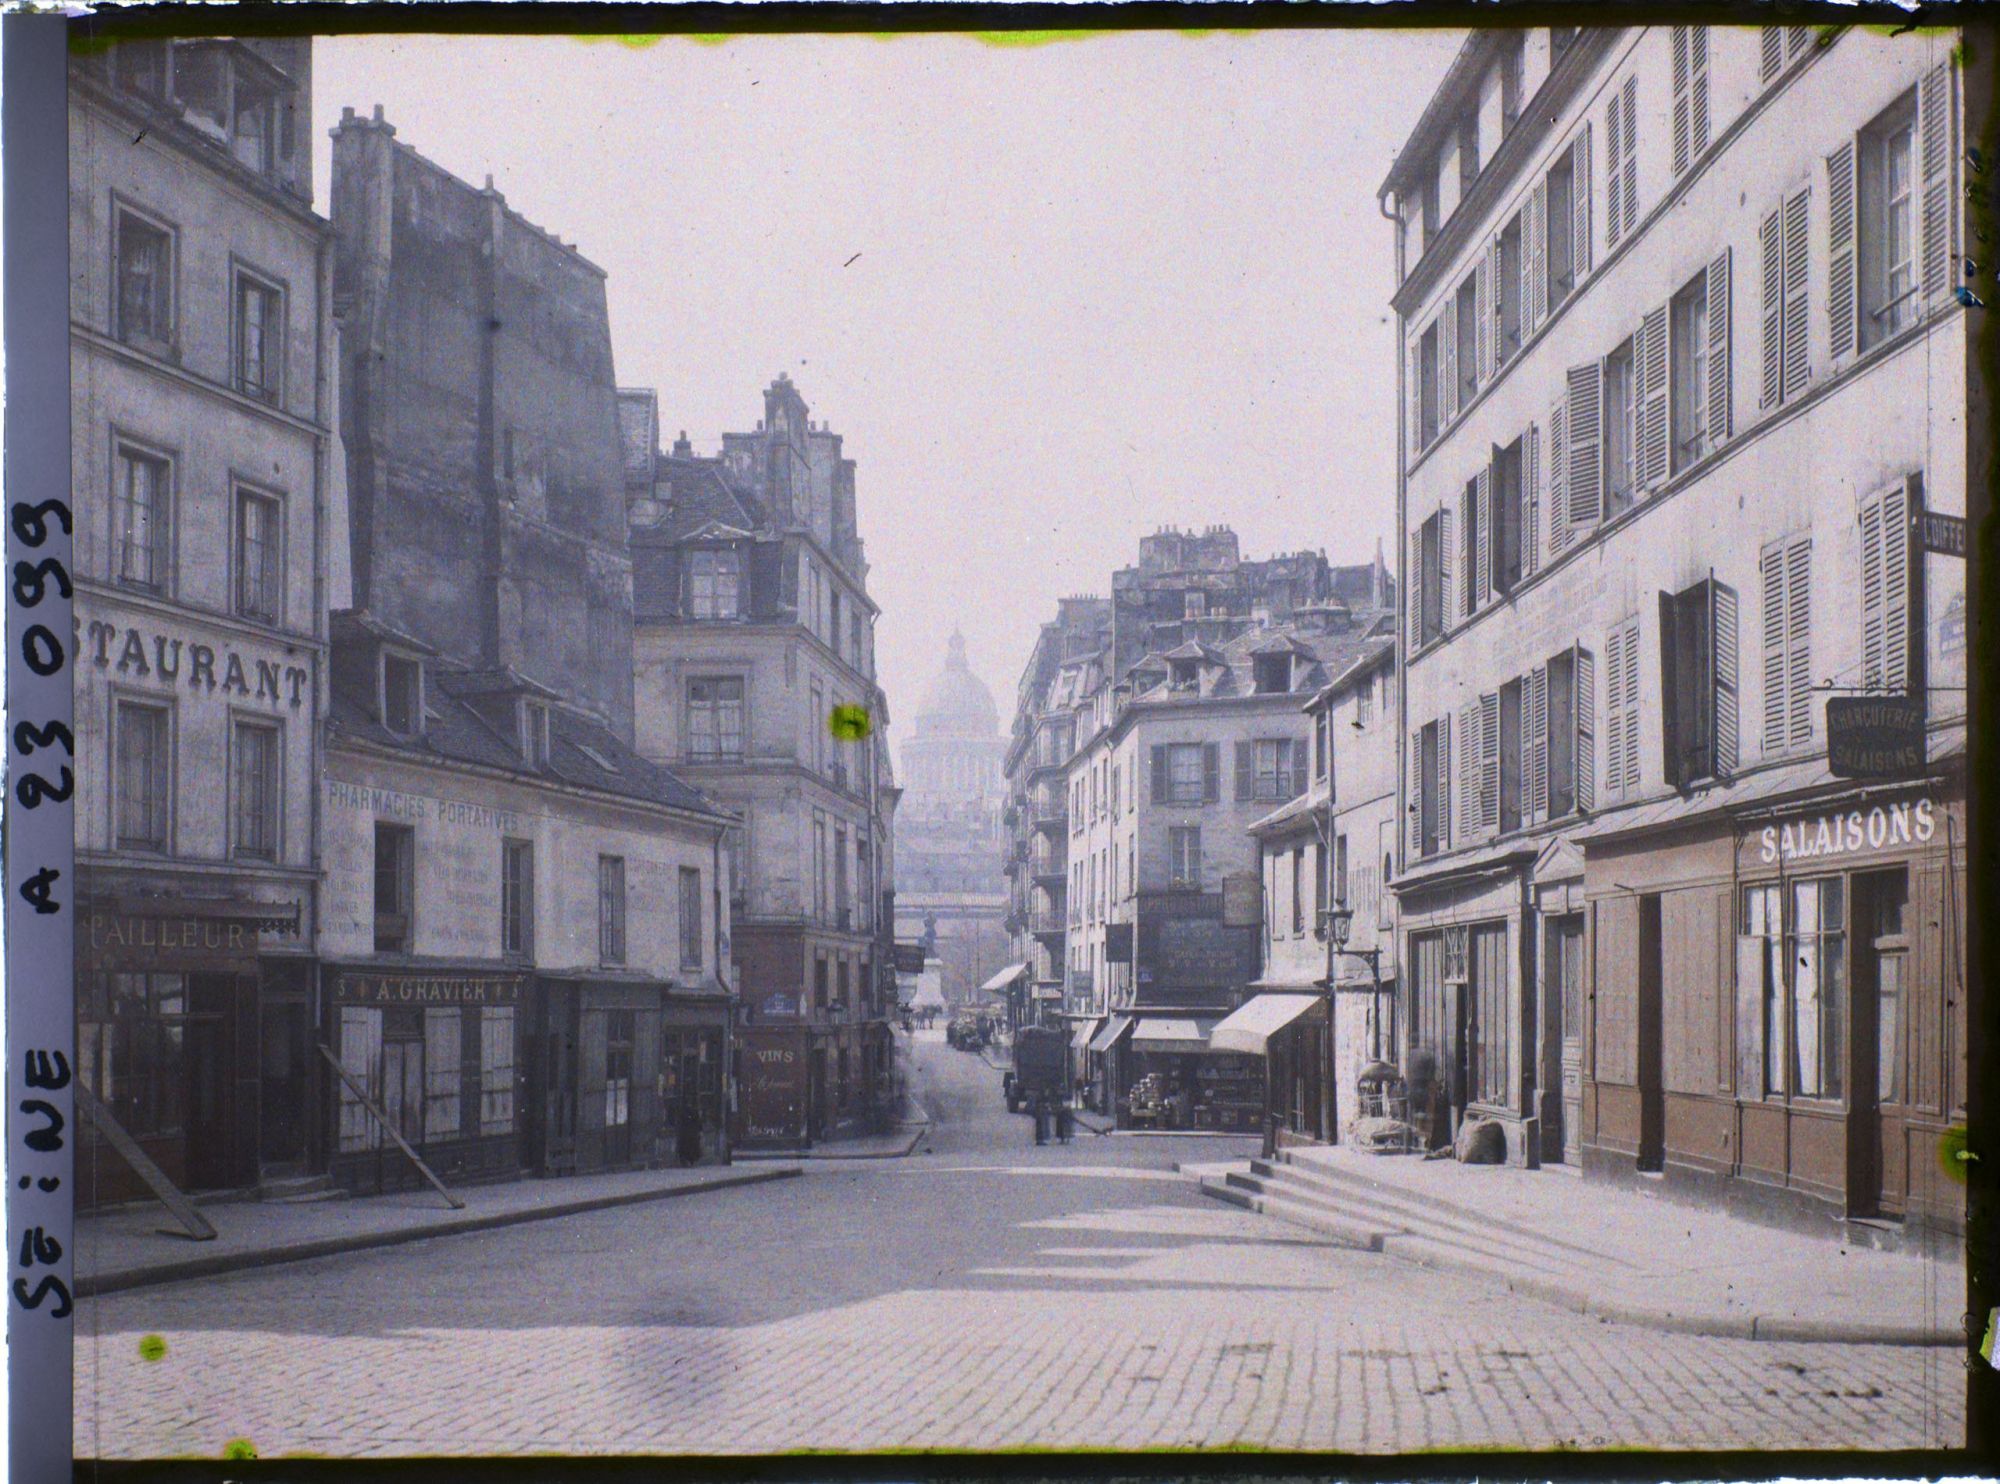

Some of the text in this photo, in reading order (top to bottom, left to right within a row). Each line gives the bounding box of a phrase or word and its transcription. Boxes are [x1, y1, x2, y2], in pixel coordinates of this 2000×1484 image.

[1923, 515, 1967, 553] COIFFE
[1829, 704, 1919, 732] CHARCUTERIE
[1832, 743, 1919, 772] SALAISONS
[328, 782, 519, 832] PHARMACIES PORTATIVES
[1760, 797, 1936, 864] SALAISONS
[20, 867, 60, 914] A
[81, 914, 244, 949] TAILLEUR
[756, 1049, 795, 1064] VINS
